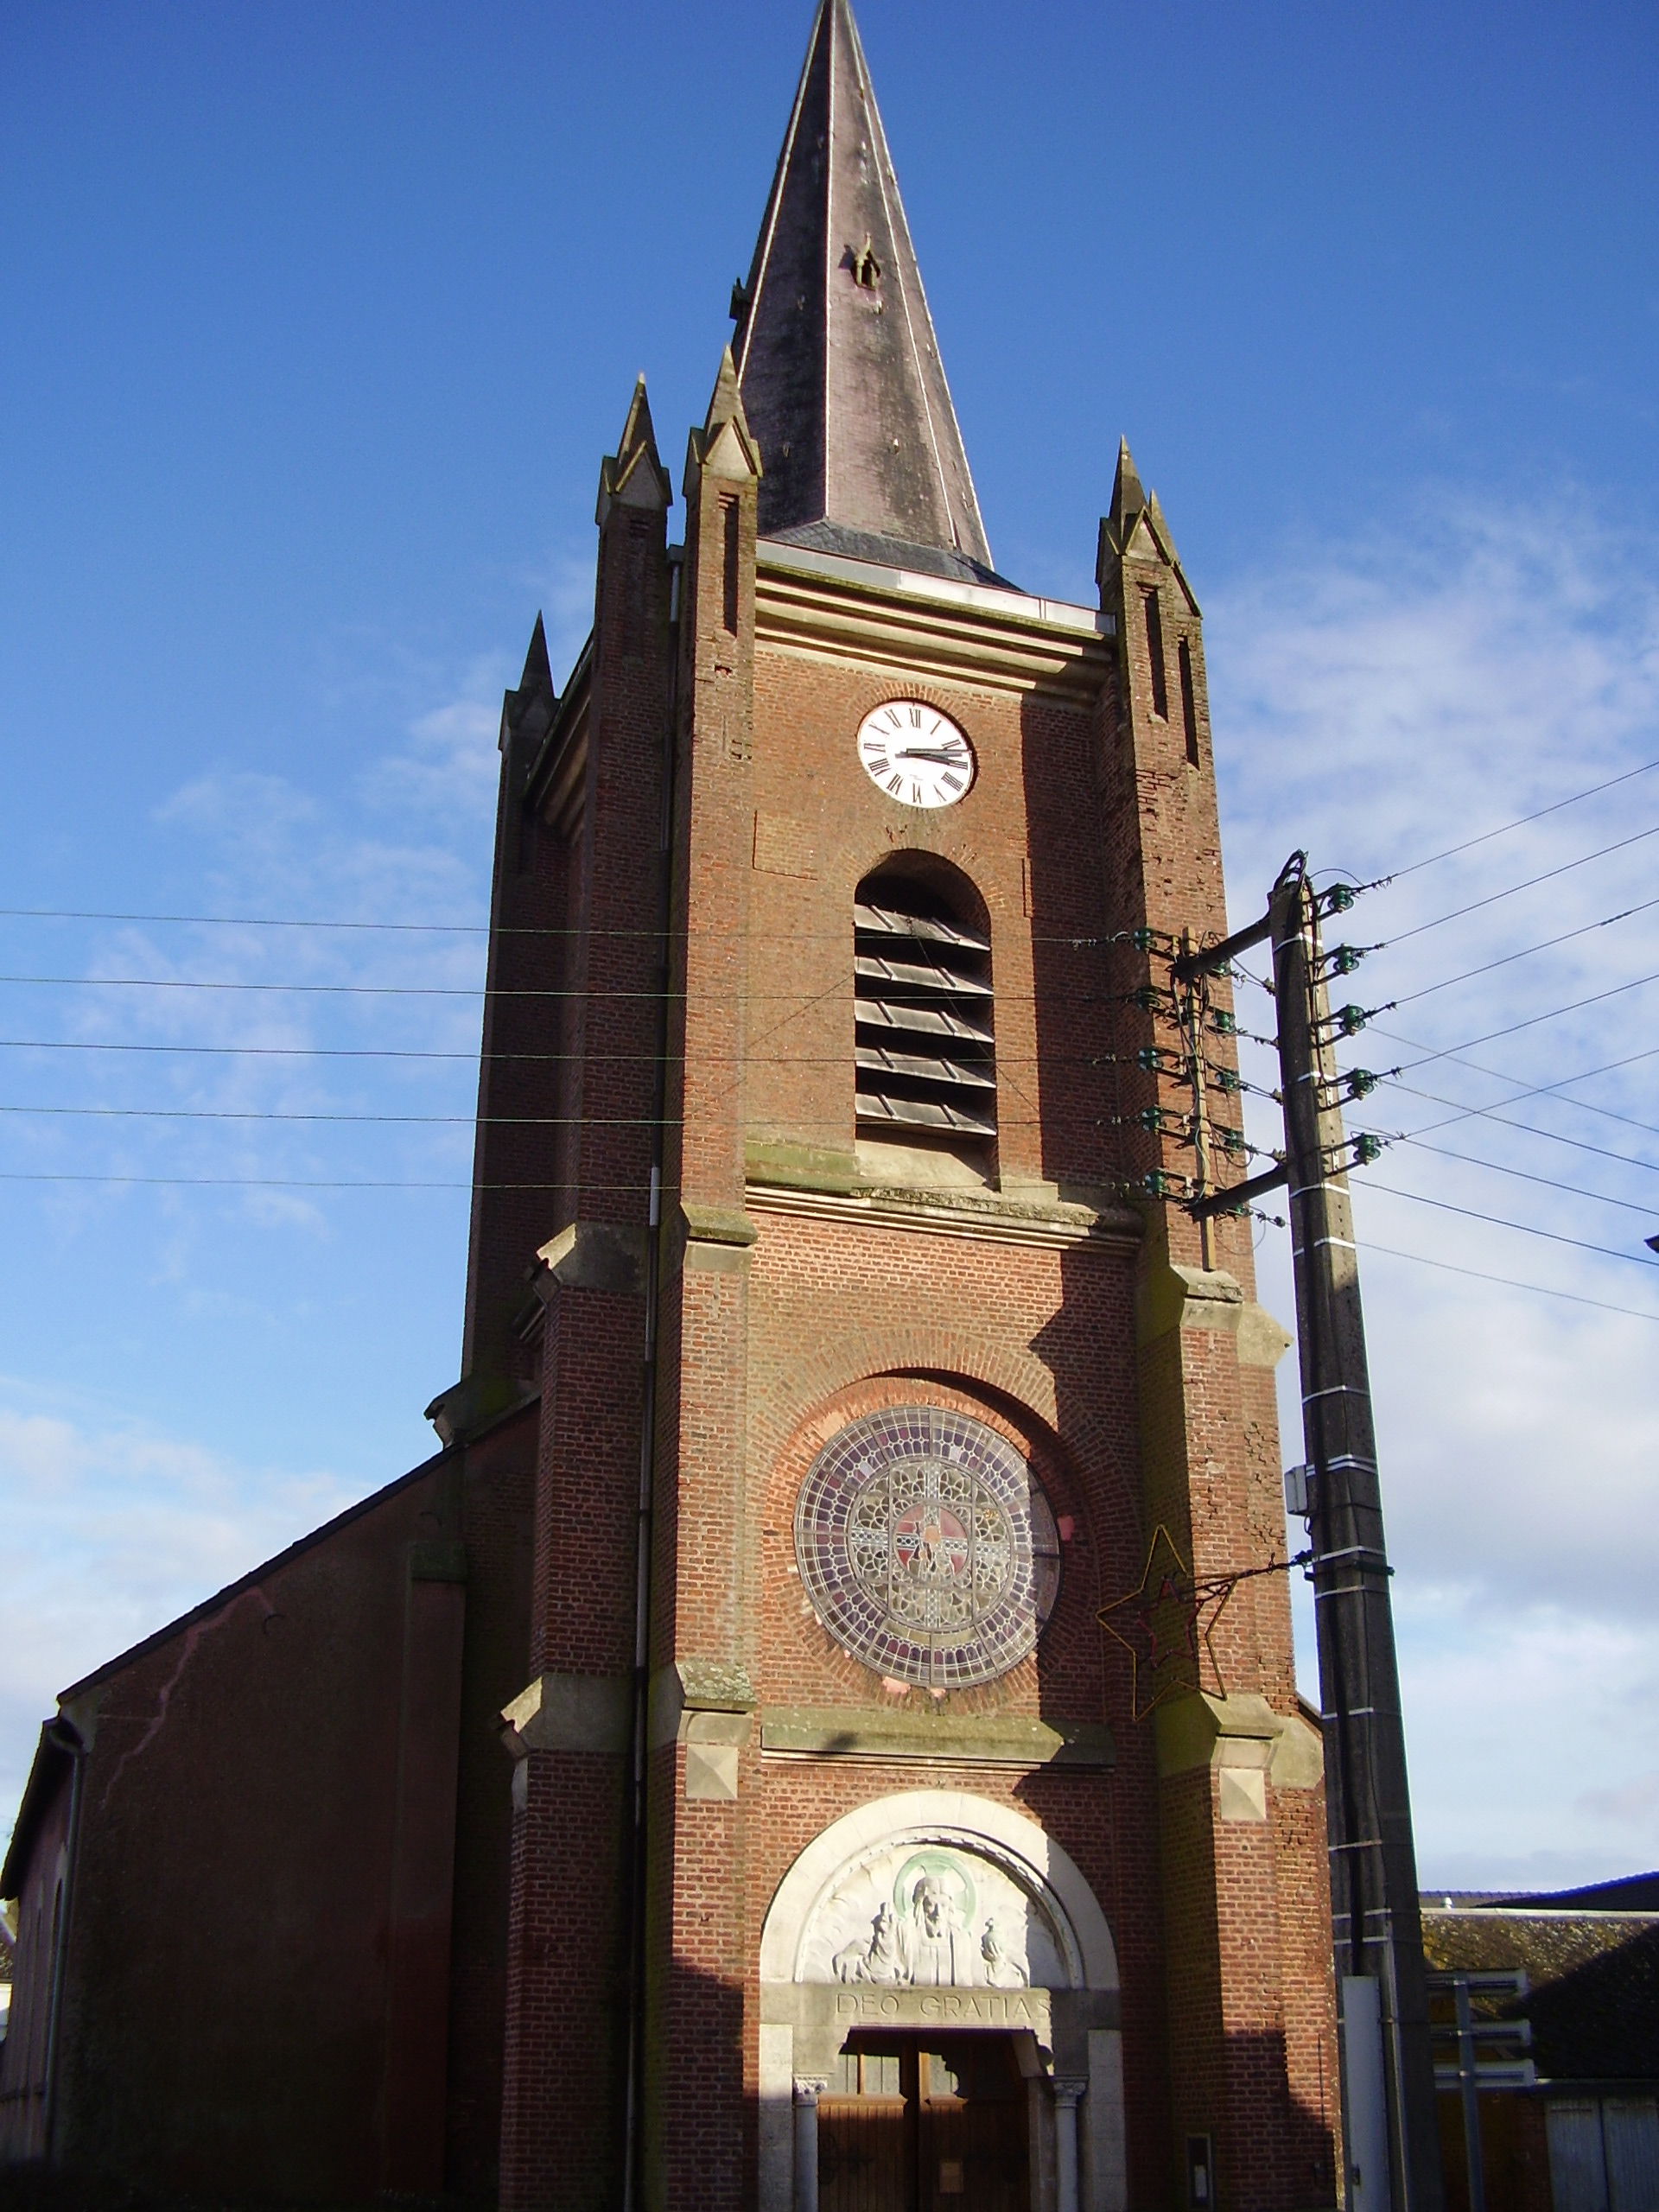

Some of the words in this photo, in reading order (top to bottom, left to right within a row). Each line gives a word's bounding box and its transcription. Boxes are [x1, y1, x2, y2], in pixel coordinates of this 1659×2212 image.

[908, 707, 921, 729] XII
[929, 719, 943, 735] I
[940, 738, 962, 749] II
[836, 1993, 900, 2017] DEO
[919, 1995, 1052, 2020] GRATIAS
